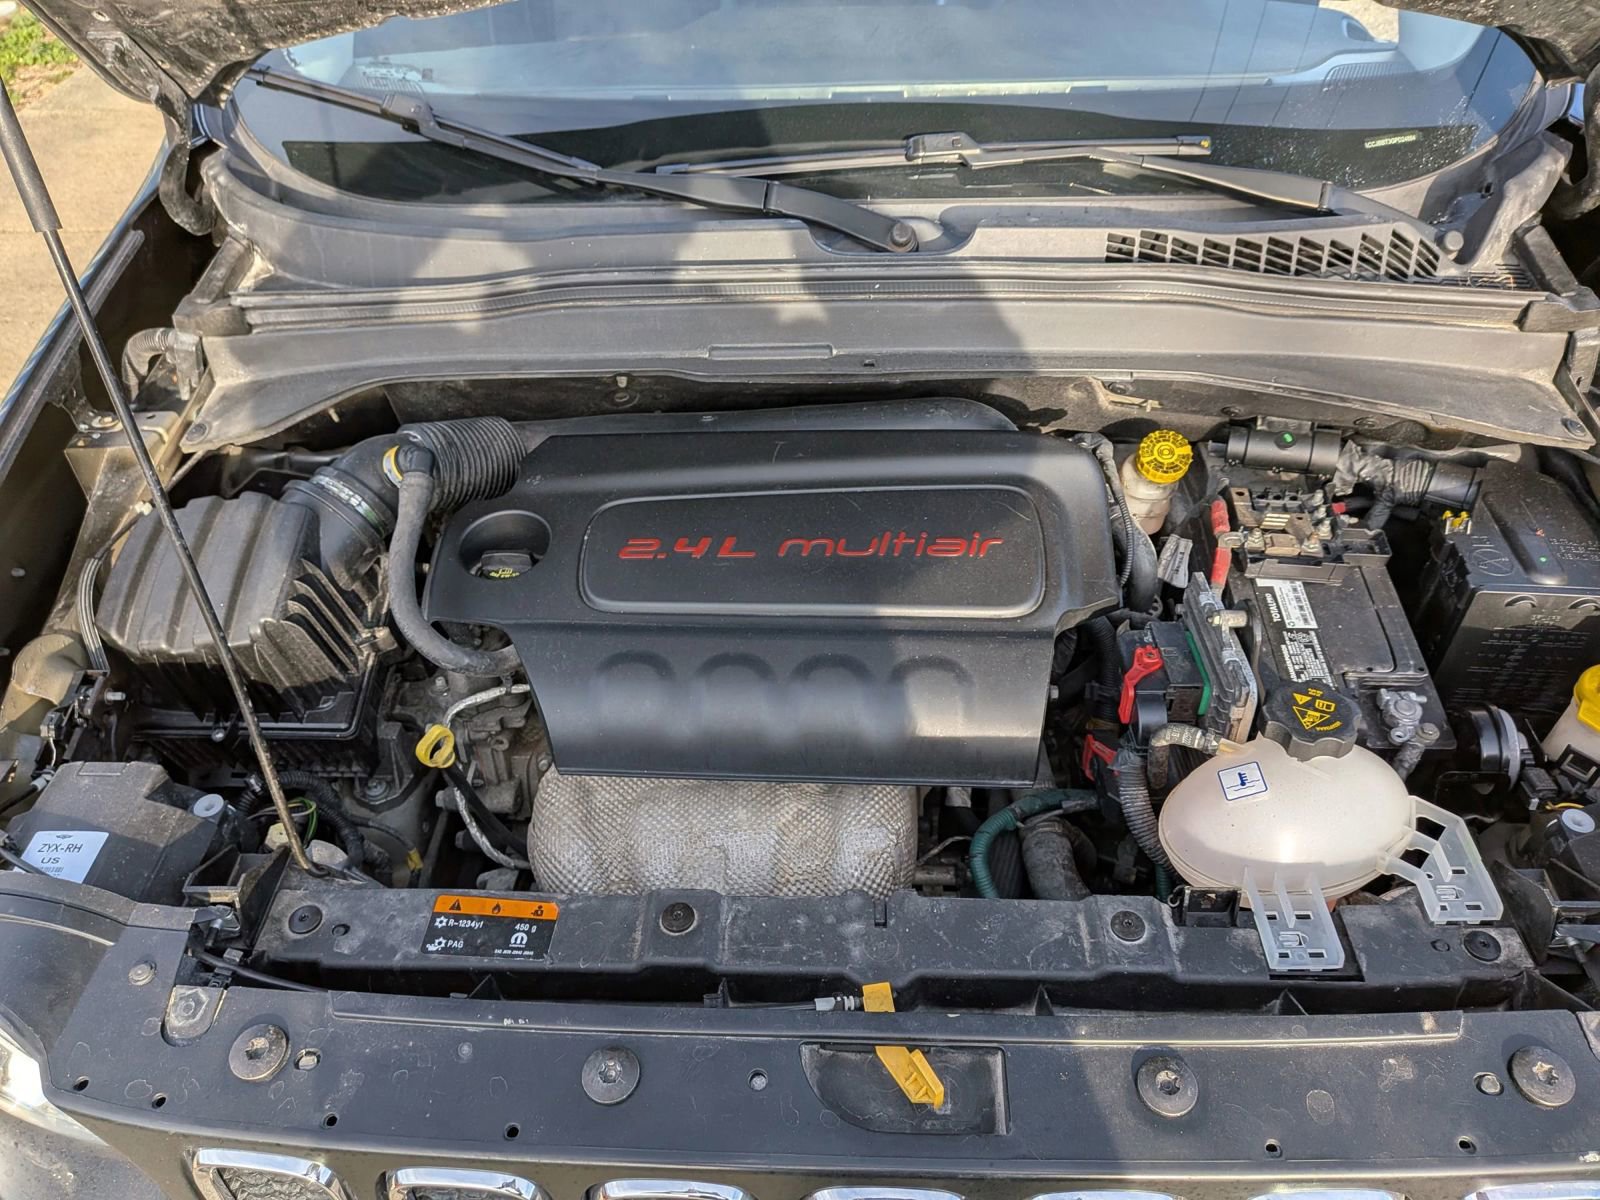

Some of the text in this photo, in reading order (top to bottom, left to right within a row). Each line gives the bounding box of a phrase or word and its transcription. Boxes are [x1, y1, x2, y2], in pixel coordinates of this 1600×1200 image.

[777, 531, 1003, 559] multiair
[37, 843, 84, 853] ZYX-RH
[41, 857, 61, 865] US
[448, 918, 484, 930] R-1234yf
[514, 923, 537, 933] 450 g
[447, 940, 464, 949] PAG
